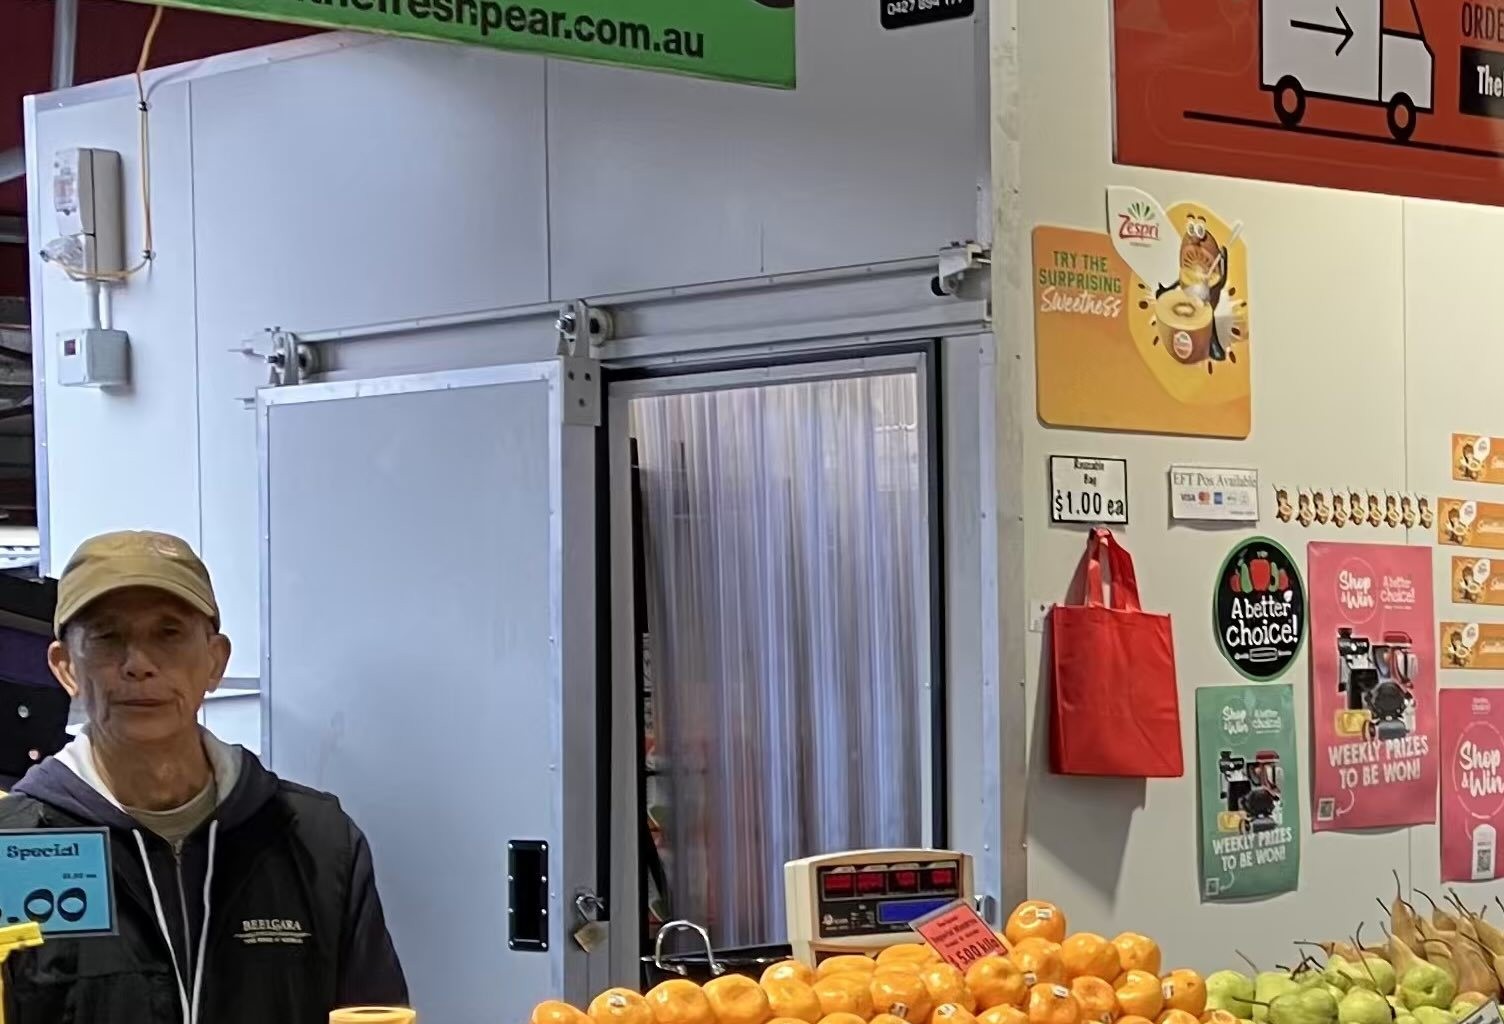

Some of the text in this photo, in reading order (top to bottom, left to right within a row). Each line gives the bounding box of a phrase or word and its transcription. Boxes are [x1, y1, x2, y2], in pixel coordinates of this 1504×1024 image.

[1119, 213, 1160, 241] Zespri
[1053, 251, 1108, 273] TRY THE
[1039, 269, 1121, 294] SURPRISING
[1041, 286, 1122, 318] Sweetness
[1173, 472, 1257, 488] EFT Pos Available
[1055, 490, 1124, 520] $1.00 ea
[1339, 570, 1372, 592] Shop
[1245, 595, 1291, 619] better
[1226, 614, 1298, 646] choice!
[1328, 735, 1429, 768] WEEKLY PRIZES
[1459, 741, 1500, 772] Shop
[1339, 767, 1357, 789] TO
[1363, 767, 1379, 785] BE
[1469, 772, 1504, 797] Win
[7, 843, 79, 861] Special
[1212, 827, 1293, 855] WEEKLY PRIZES
[1221, 854, 1236, 871] TO
[1240, 851, 1253, 868] BE
[0, 887, 87, 923] .00
